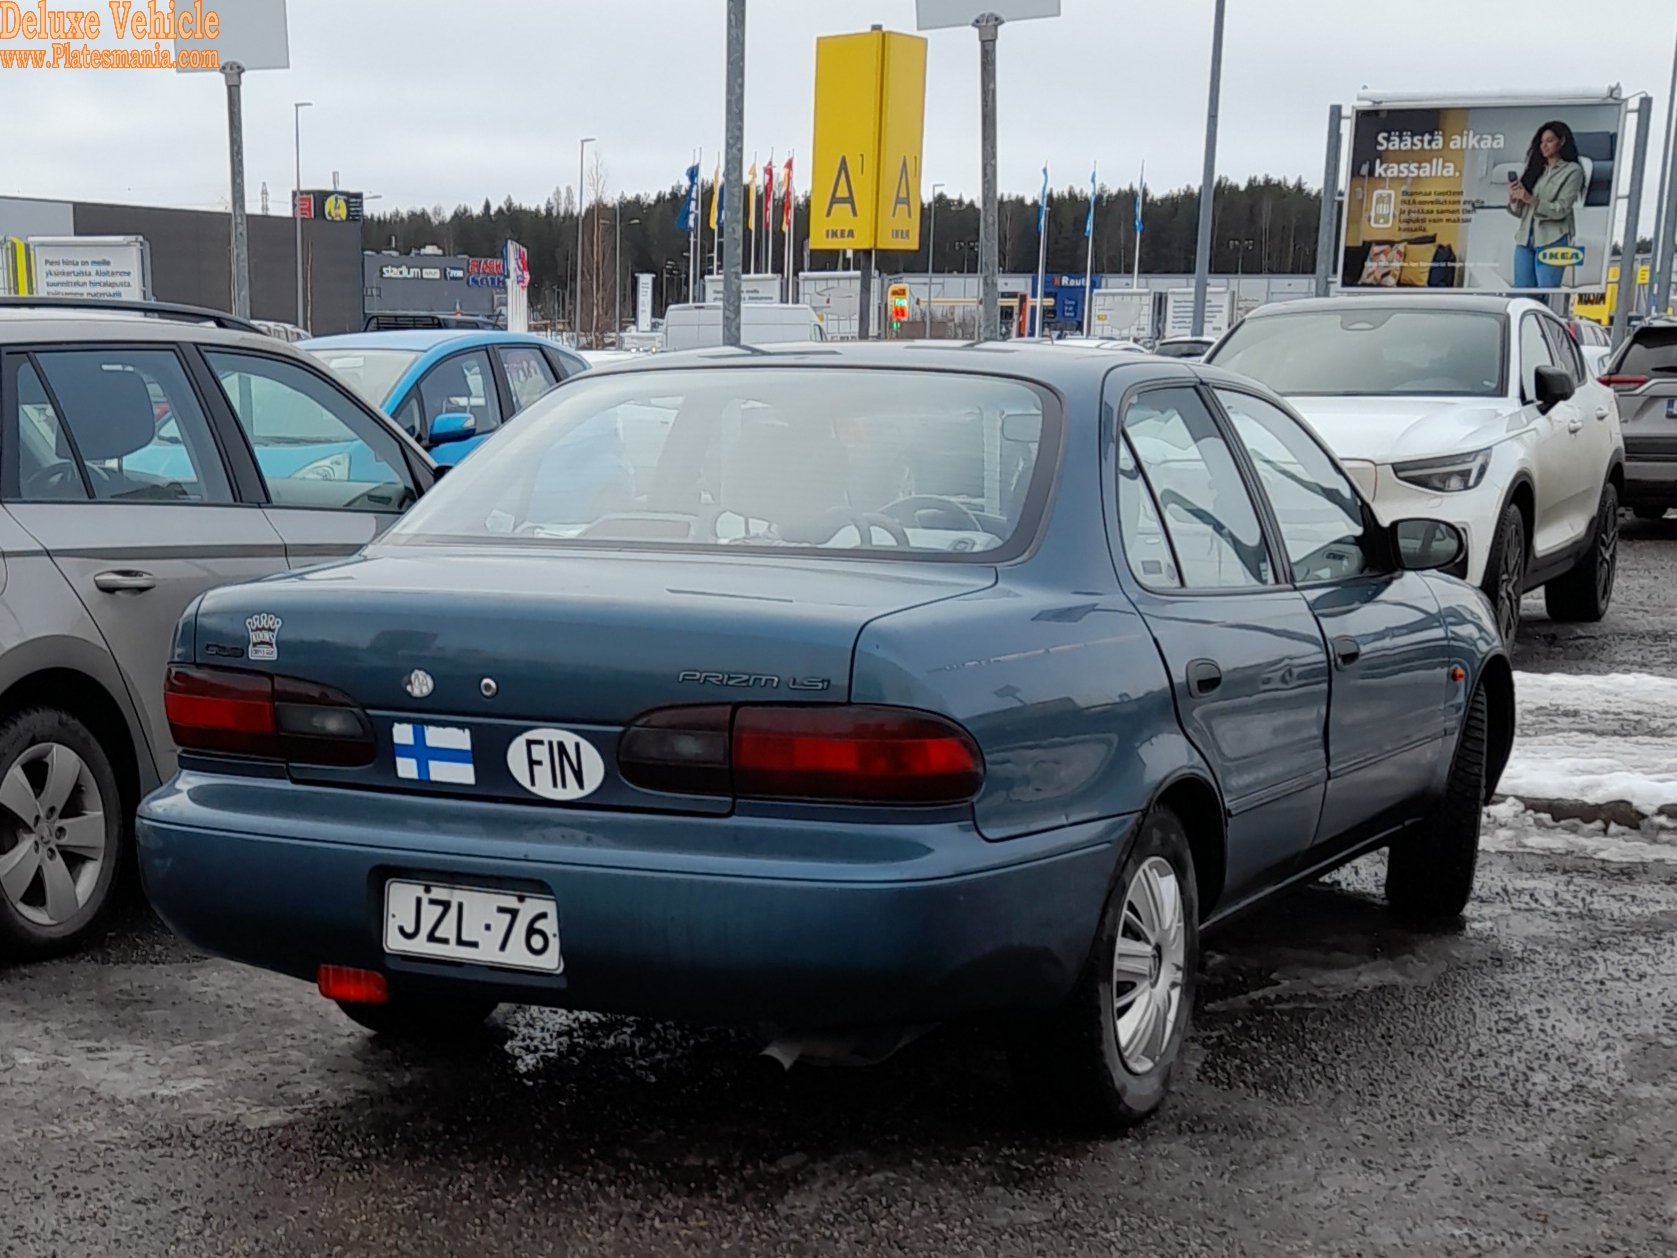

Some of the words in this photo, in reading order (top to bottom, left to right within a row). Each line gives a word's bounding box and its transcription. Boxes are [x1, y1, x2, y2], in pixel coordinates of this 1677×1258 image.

[1376, 130, 1444, 151] Säästä
[1449, 130, 1505, 149] aikaa
[1374, 158, 1460, 178] kassalla.
[825, 154, 858, 218] A
[891, 154, 912, 219] A
[825, 229, 855, 239] IKEA
[1541, 252, 1580, 260] IKEA
[382, 265, 421, 279] stadium
[1062, 275, 1088, 286] Raut
[678, 670, 780, 688] PRIZM
[788, 677, 831, 691] LSi
[525, 739, 585, 791] FIN
